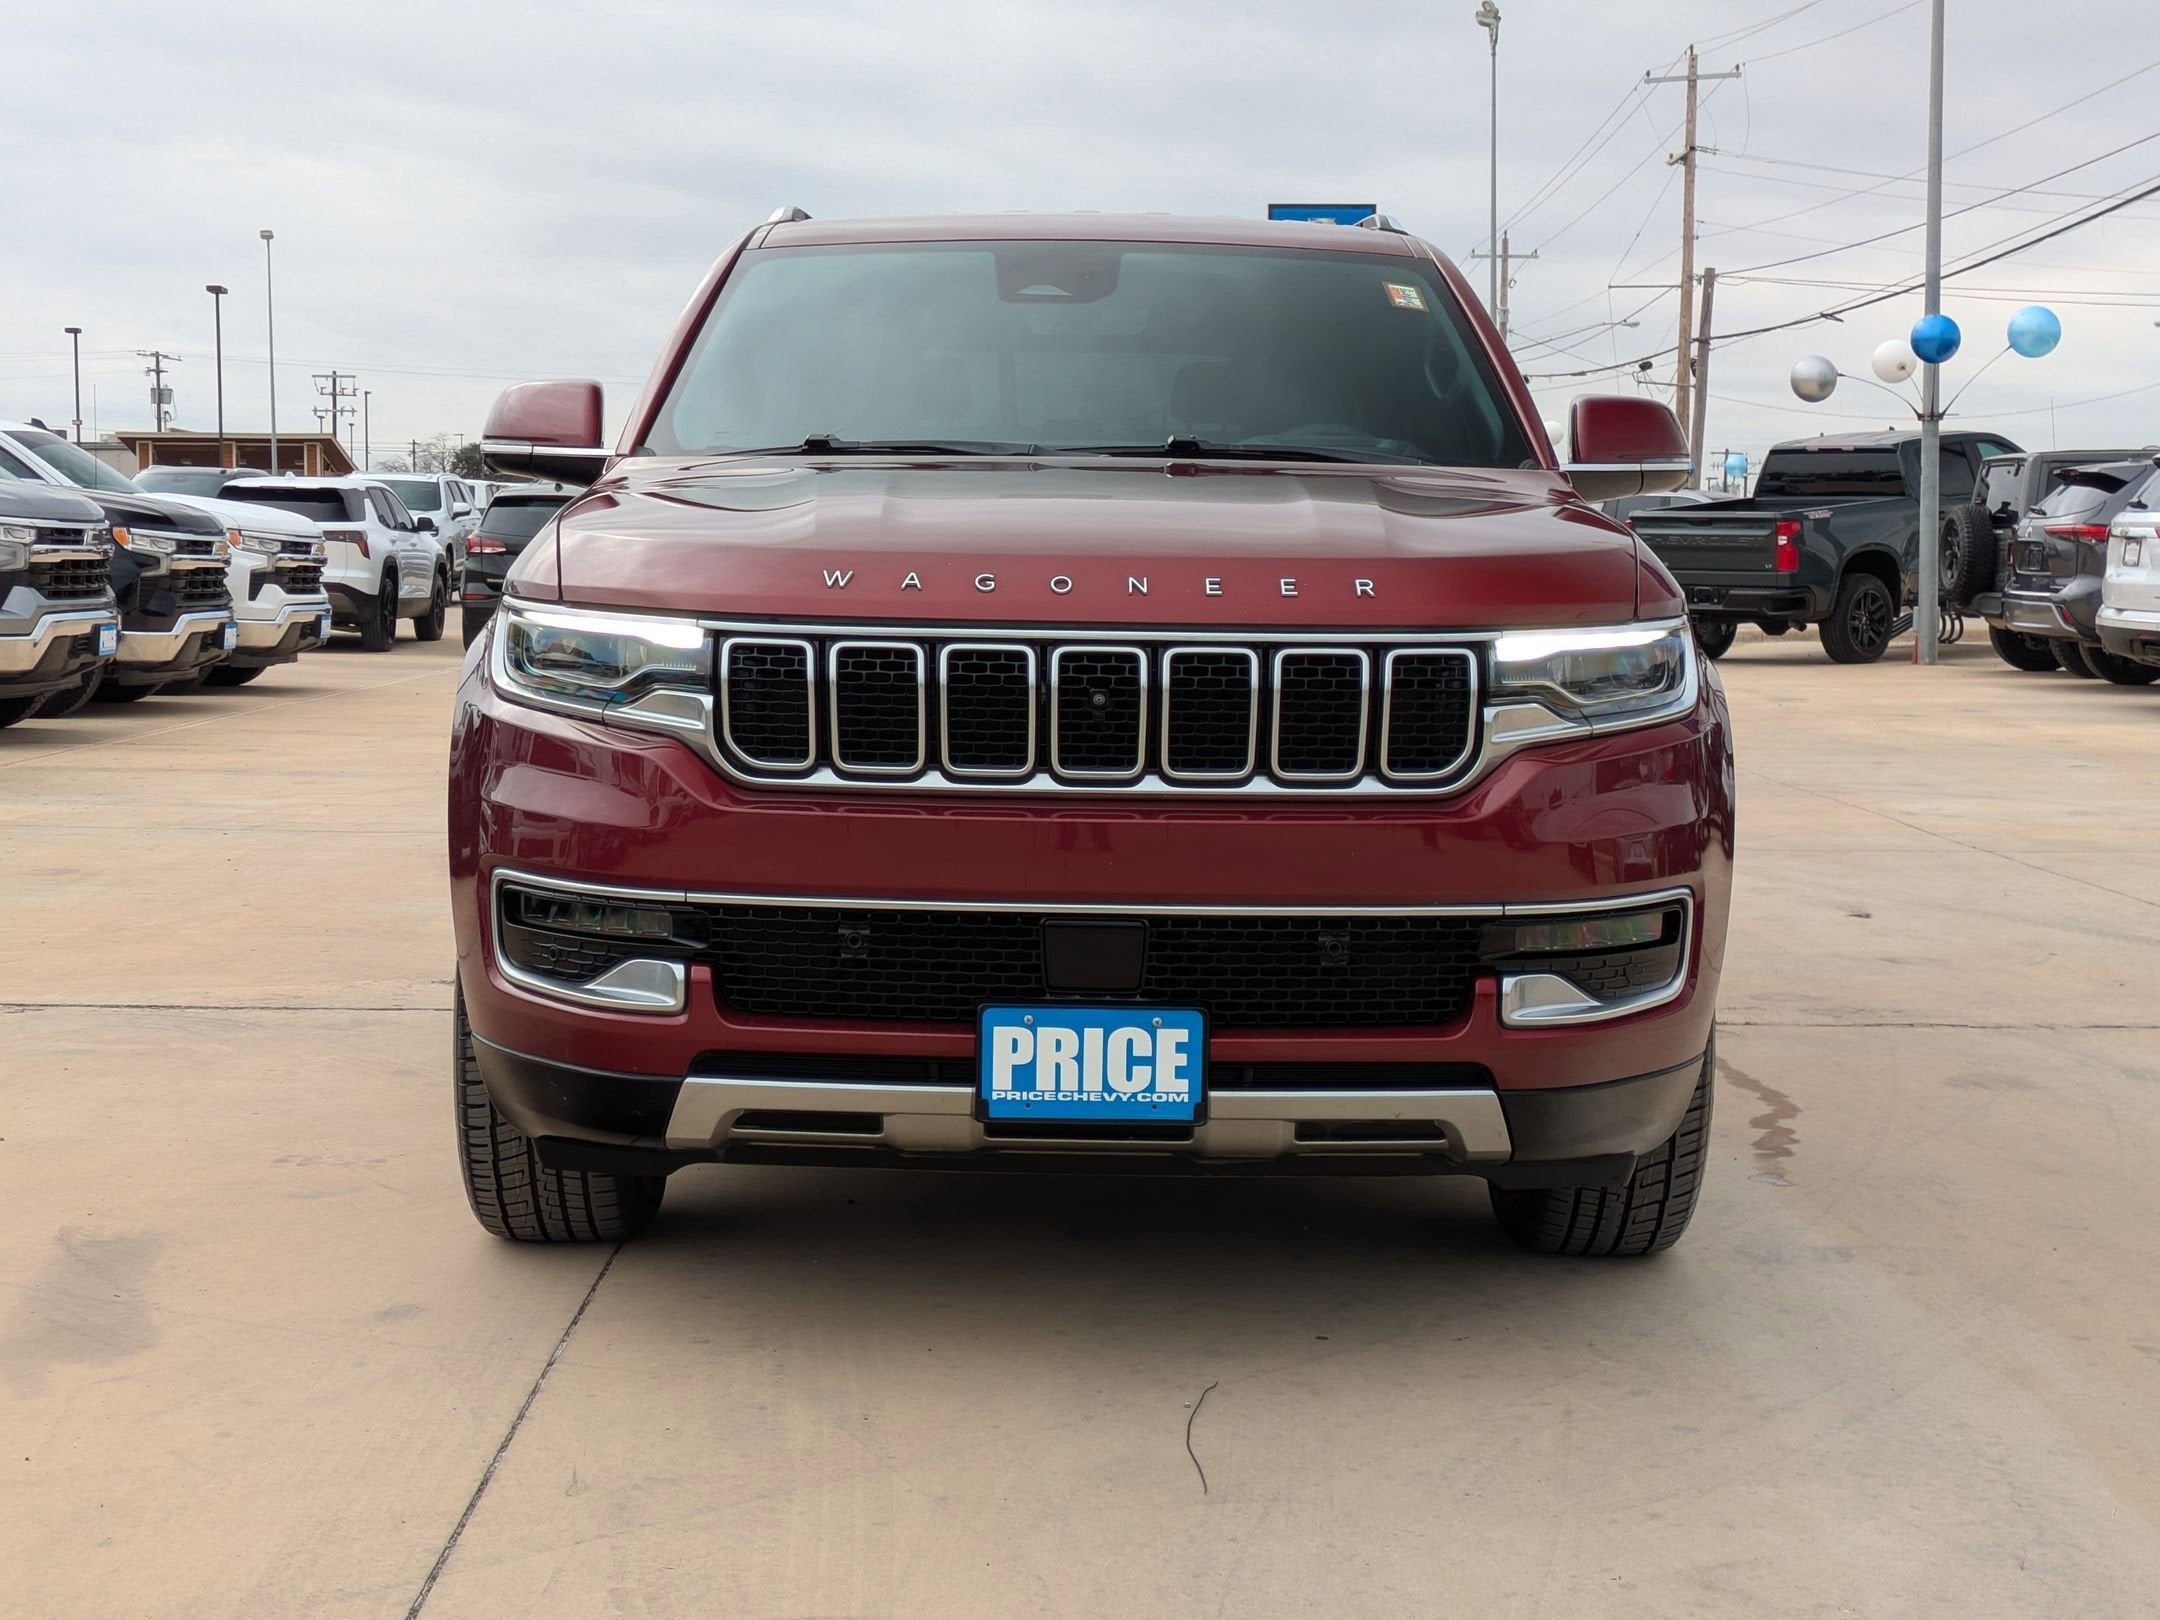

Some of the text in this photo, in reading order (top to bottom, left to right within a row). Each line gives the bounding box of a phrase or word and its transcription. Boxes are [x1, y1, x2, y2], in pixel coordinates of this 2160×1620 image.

[822, 569, 1376, 598] WAGONEER
[992, 1026, 1189, 1093] PRICE
[992, 1091, 1189, 1103] PRICECHEVY.COM
